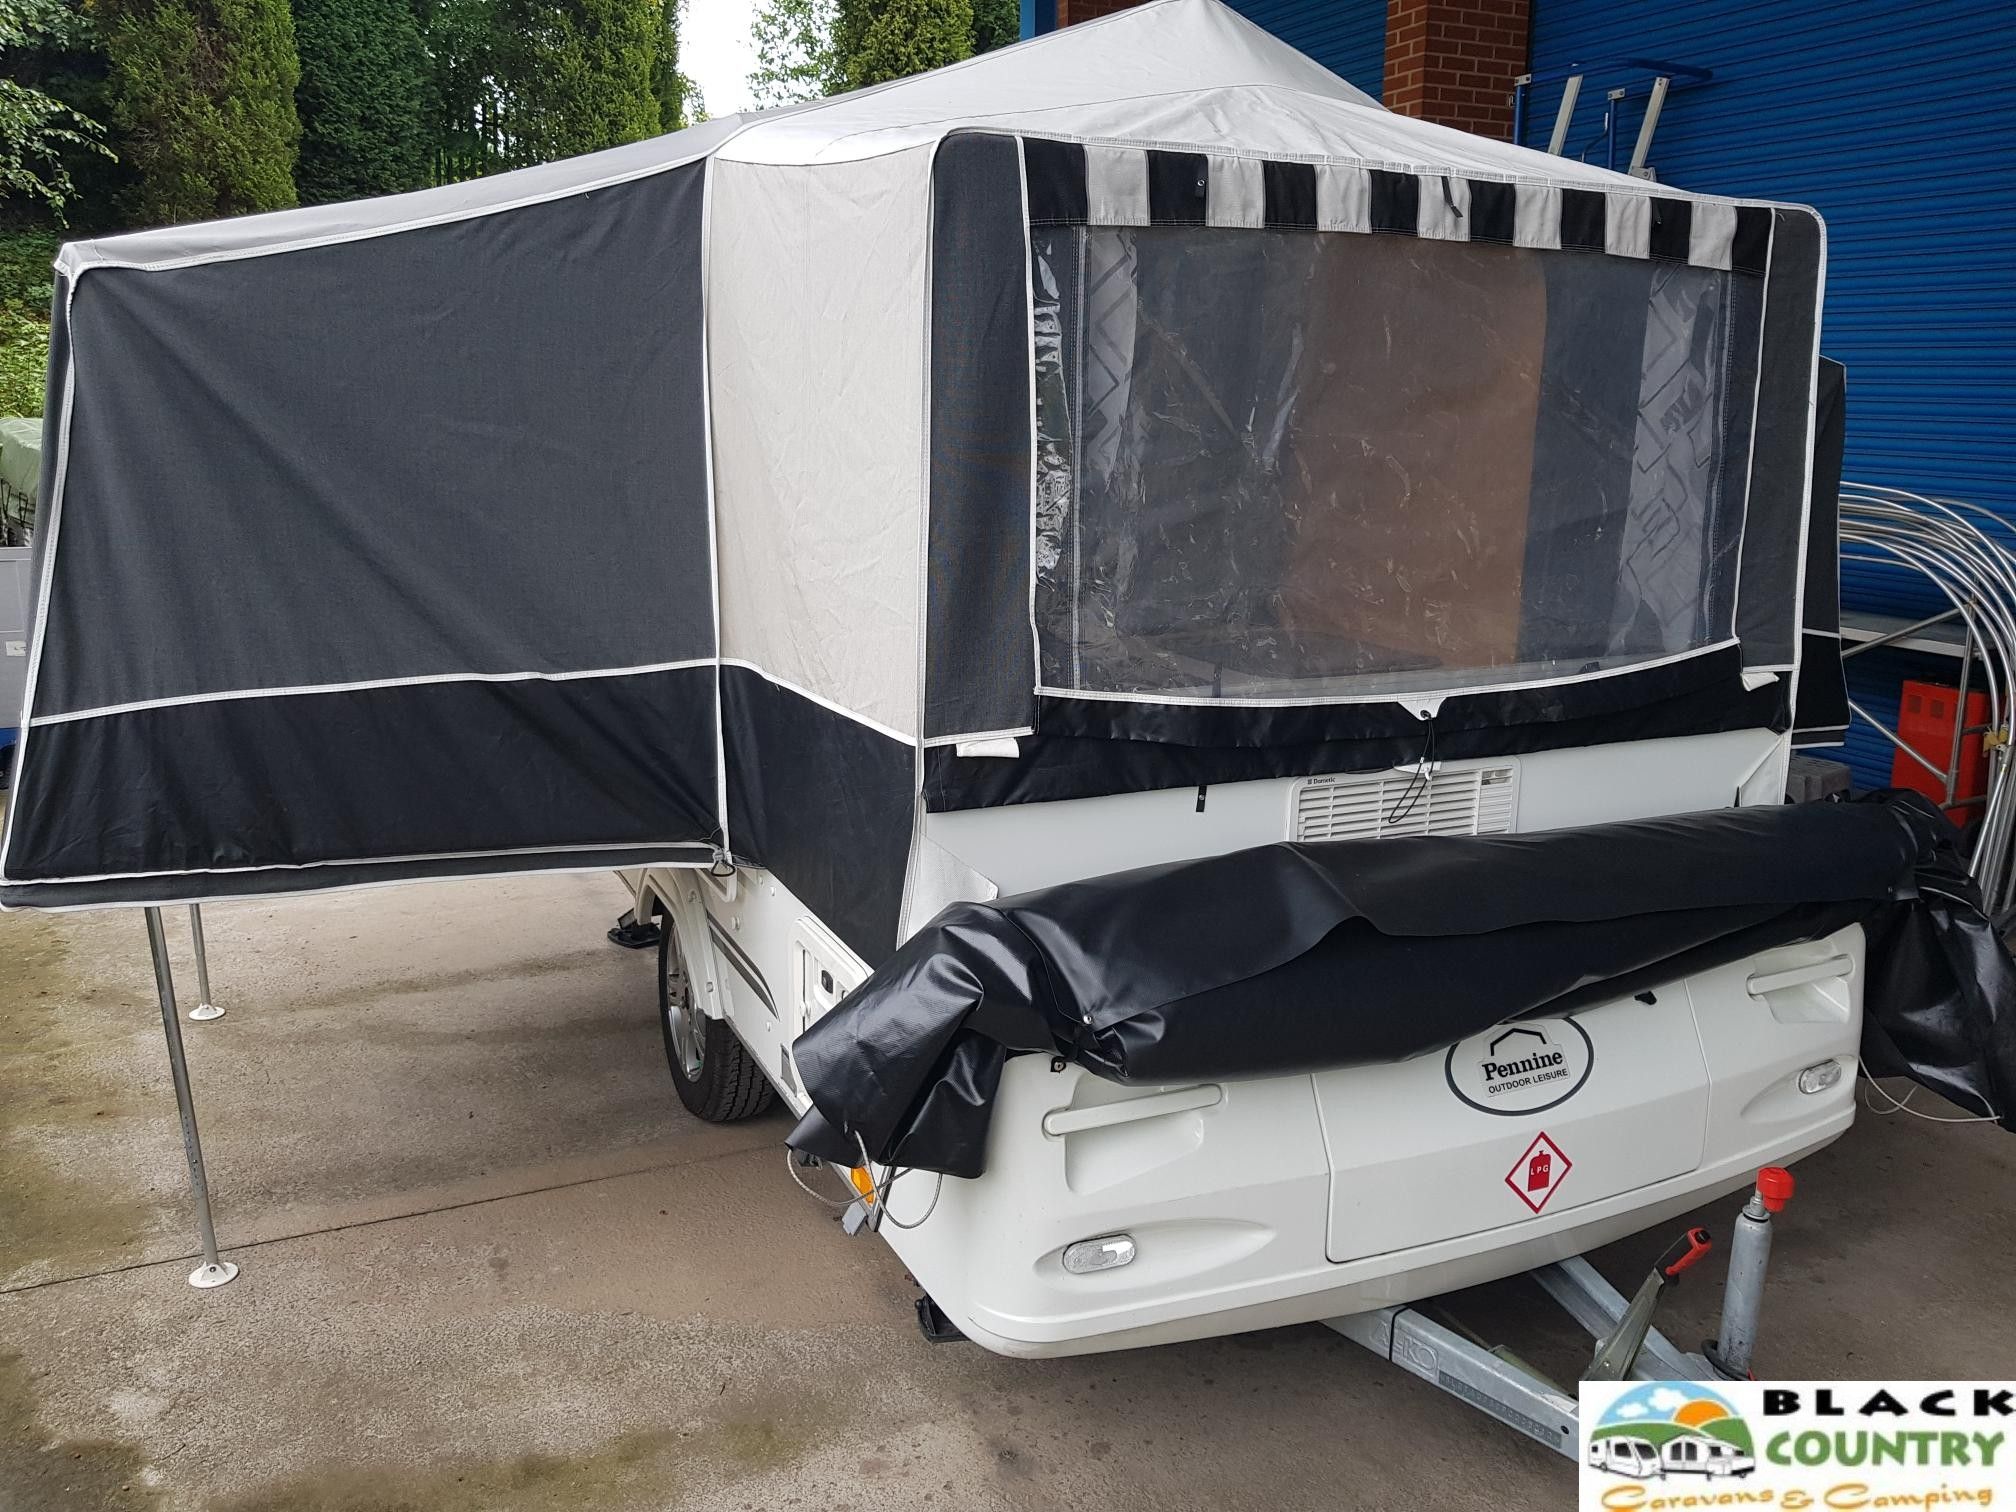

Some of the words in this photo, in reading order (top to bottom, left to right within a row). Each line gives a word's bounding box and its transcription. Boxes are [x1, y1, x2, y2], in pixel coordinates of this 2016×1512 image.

[1481, 1052, 1563, 1081] Pennine
[1488, 1077, 1532, 1094] OUTDOOR
[1532, 1068, 1569, 1084] LEISURE
